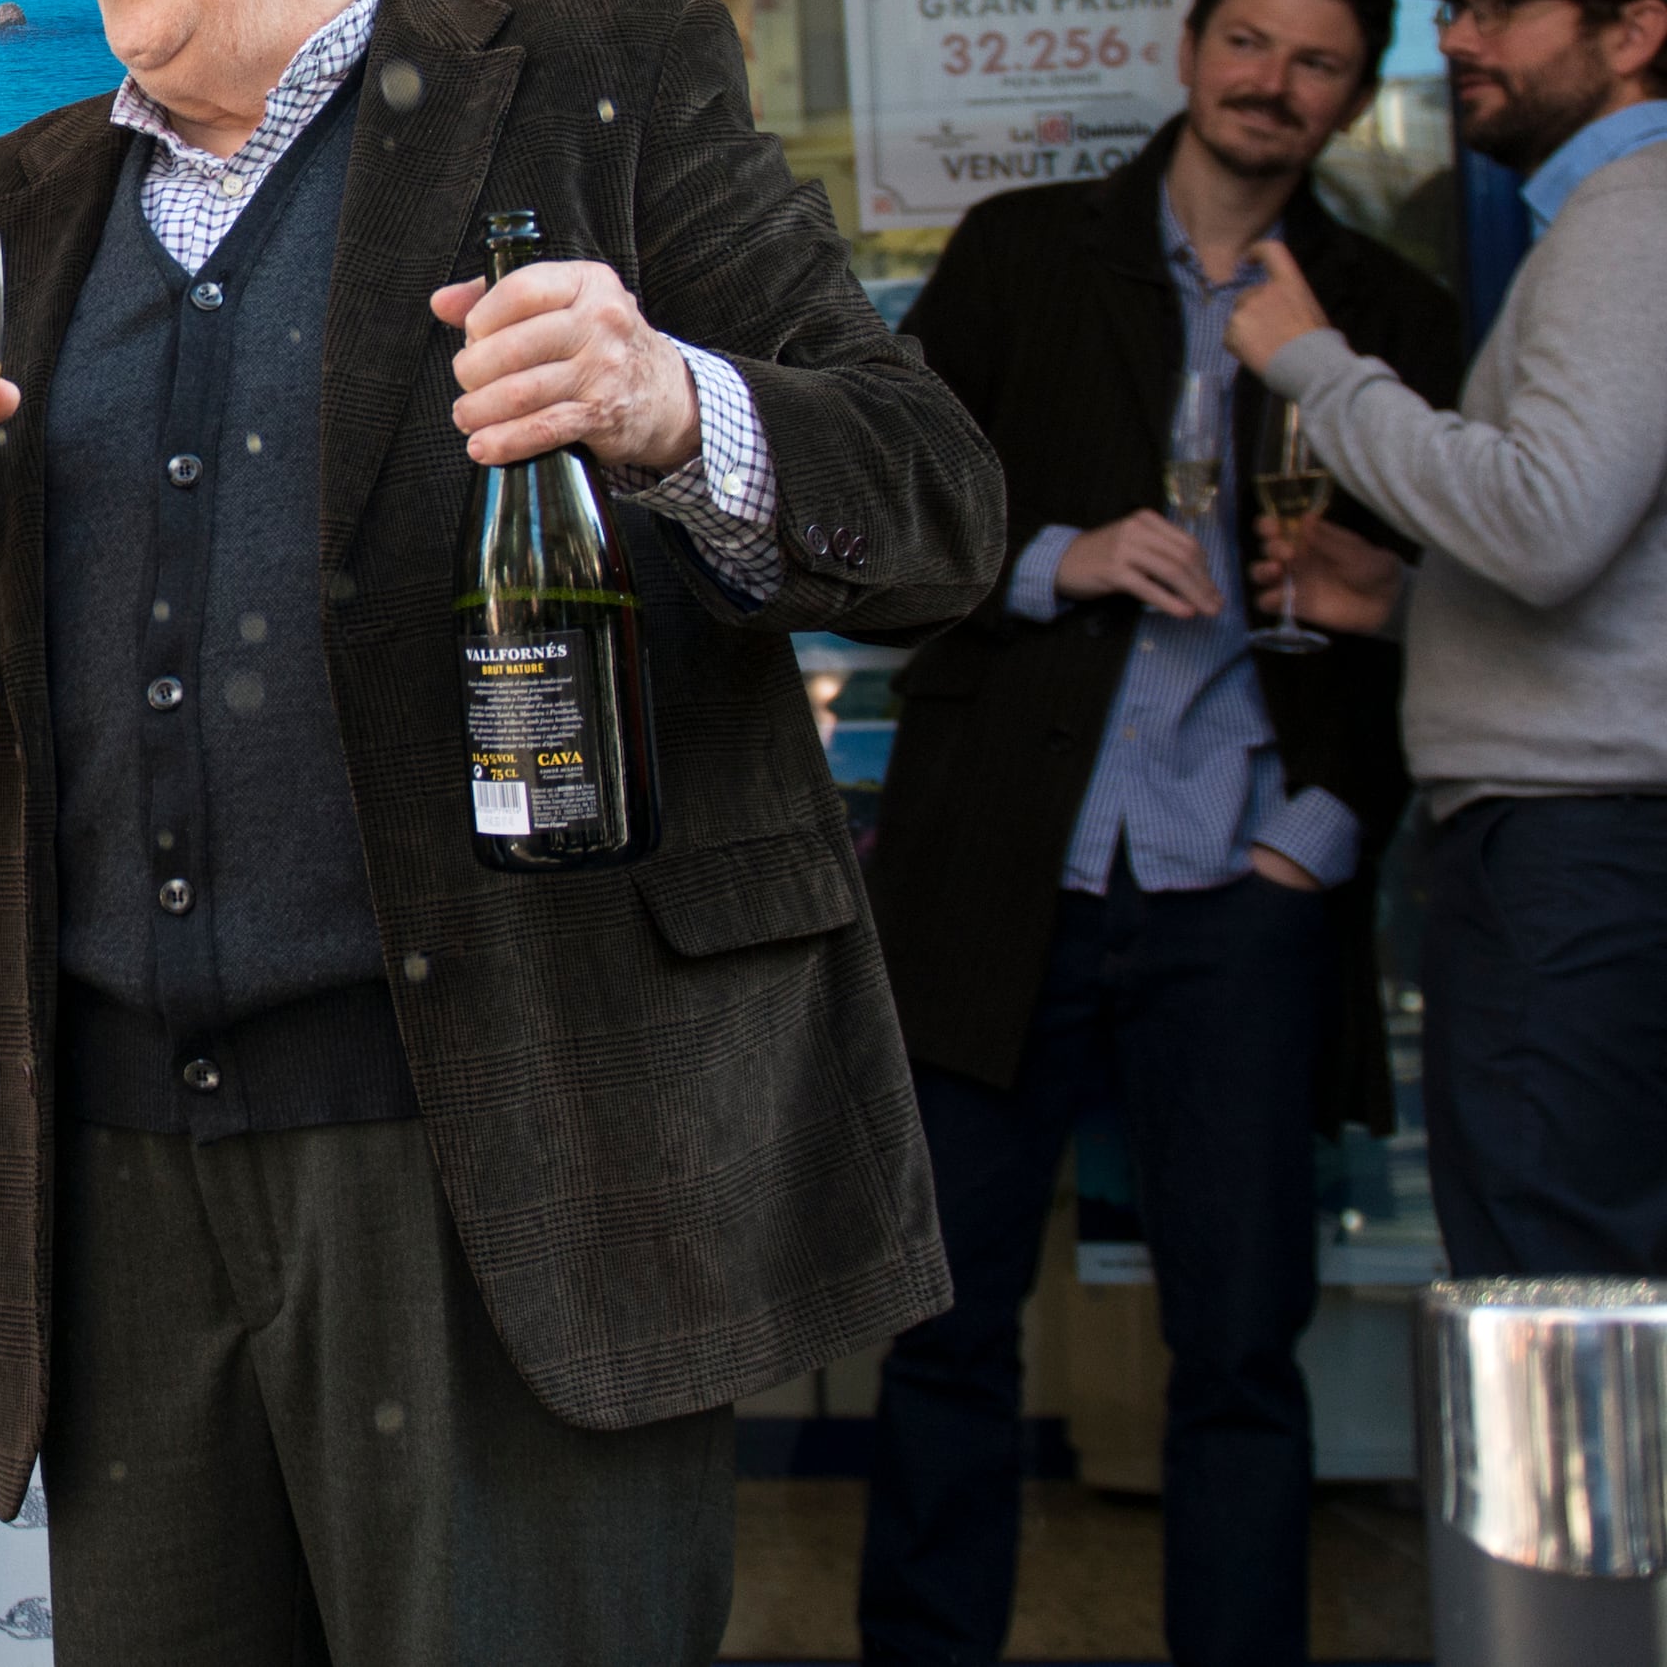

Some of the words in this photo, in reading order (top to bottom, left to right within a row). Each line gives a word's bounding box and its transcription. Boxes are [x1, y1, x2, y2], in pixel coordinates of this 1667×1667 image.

[941, 26, 1131, 76] 32.256
[1138, 41, 1161, 66] €
[941, 149, 1060, 182] VENUT
[465, 642, 568, 662] VALLFORNÉS
[482, 665, 504, 676] BRUT
[506, 662, 545, 675] NATURE
[537, 751, 584, 767] CAVA
[490, 768, 505, 782] 75
[504, 768, 519, 779] CL
